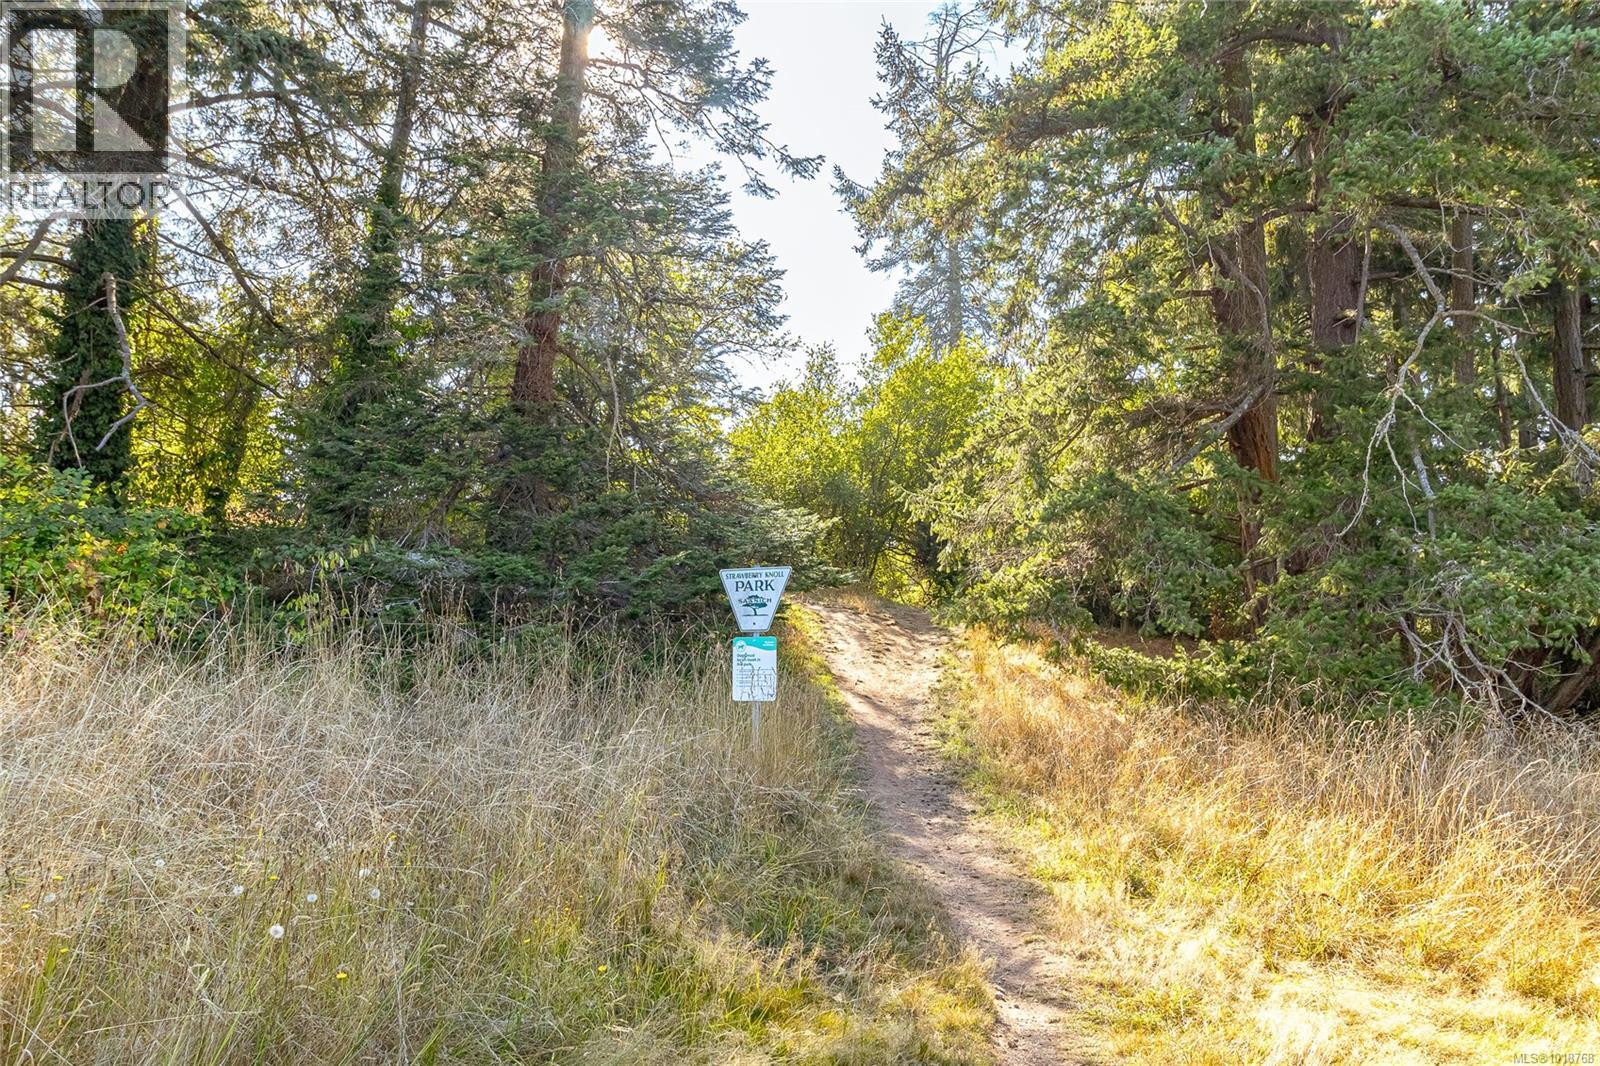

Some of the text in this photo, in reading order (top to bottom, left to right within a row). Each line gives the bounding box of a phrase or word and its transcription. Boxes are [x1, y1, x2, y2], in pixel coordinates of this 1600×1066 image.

[725, 570, 785, 580] STRAWBERRY KNOLL
[735, 579, 775, 592] PARK
